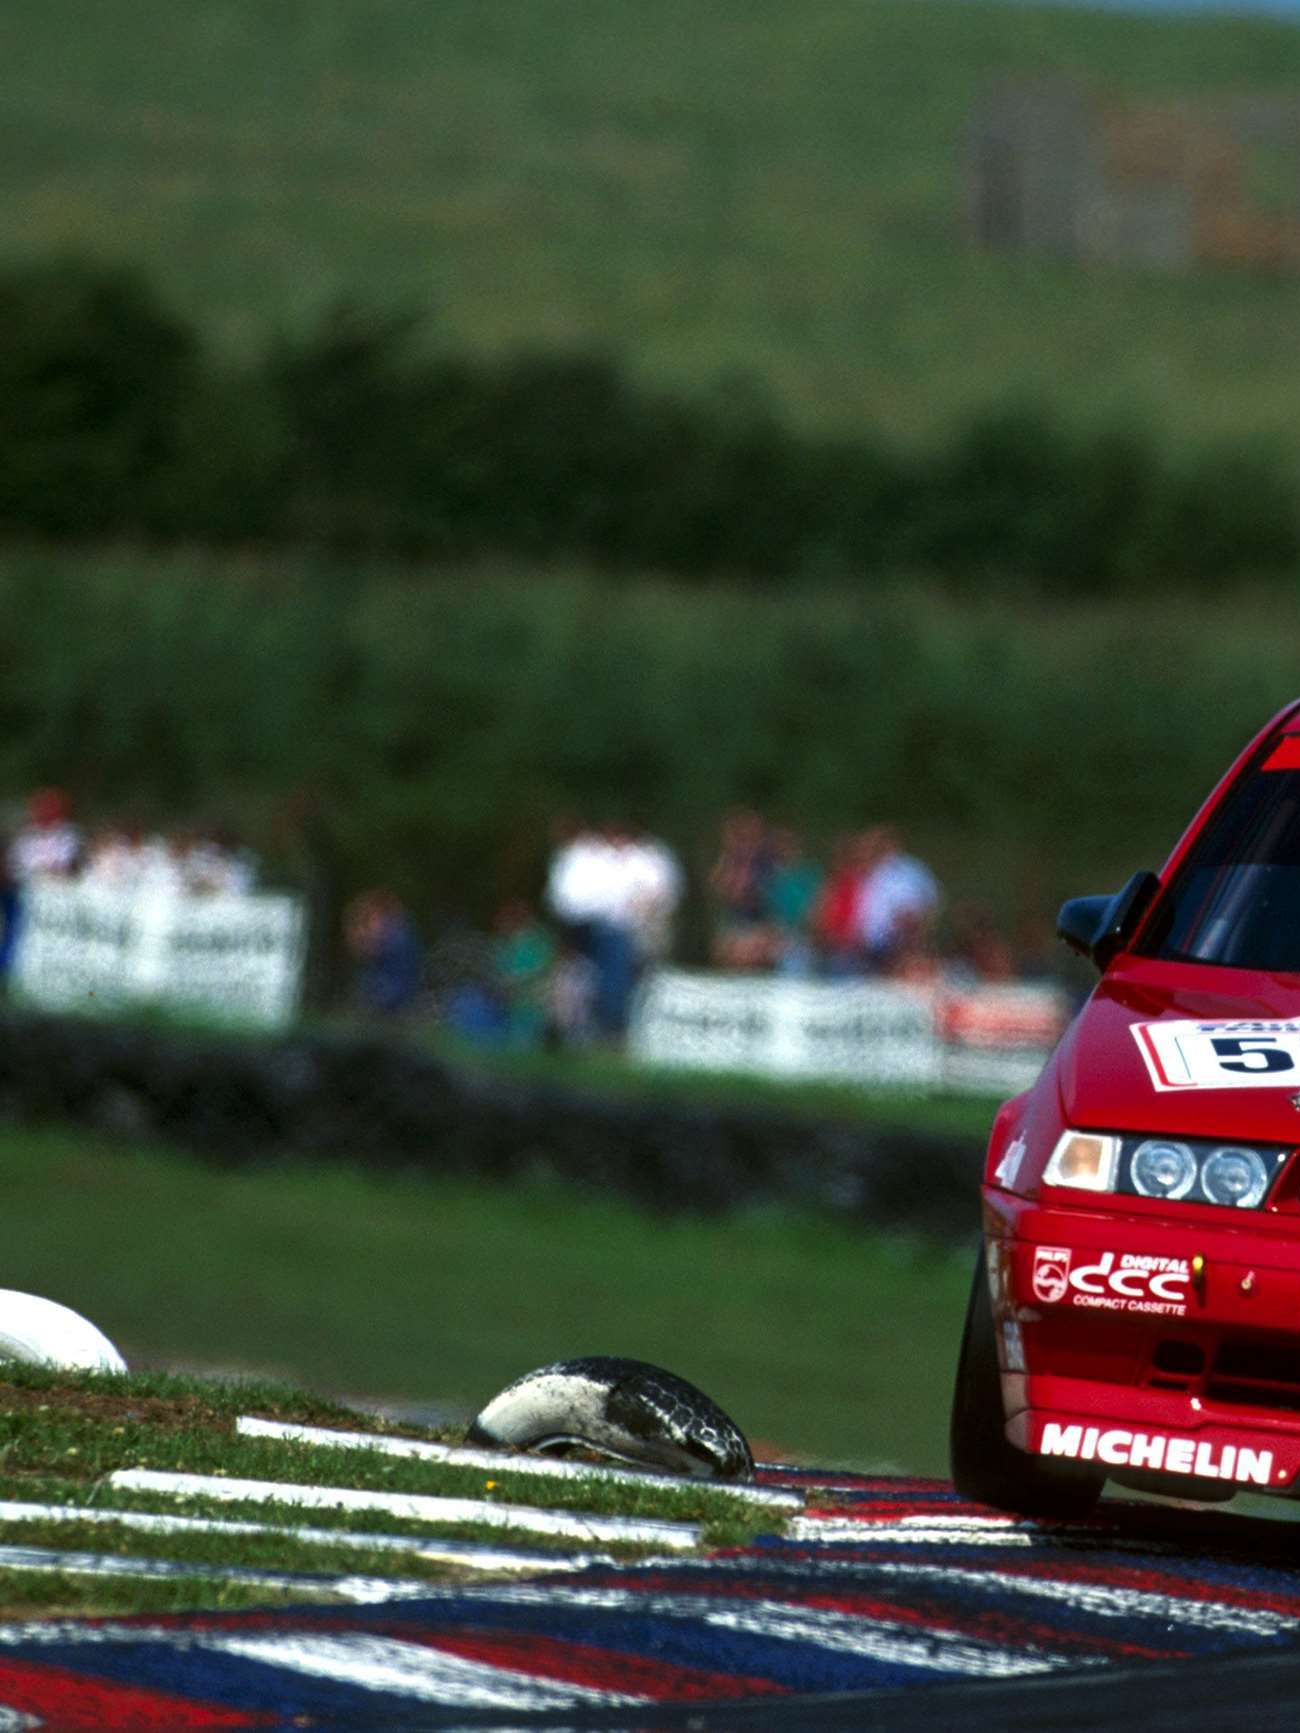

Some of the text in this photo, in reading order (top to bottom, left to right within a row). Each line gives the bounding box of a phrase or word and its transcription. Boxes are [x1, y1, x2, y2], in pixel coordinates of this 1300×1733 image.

[1069, 1252, 1189, 1300] dcc
[1120, 1254, 1188, 1273] DIGITAL
[1073, 1294, 1187, 1317] COMPACT CASSETTE
[1041, 1423, 1274, 1485] MICHELIN
